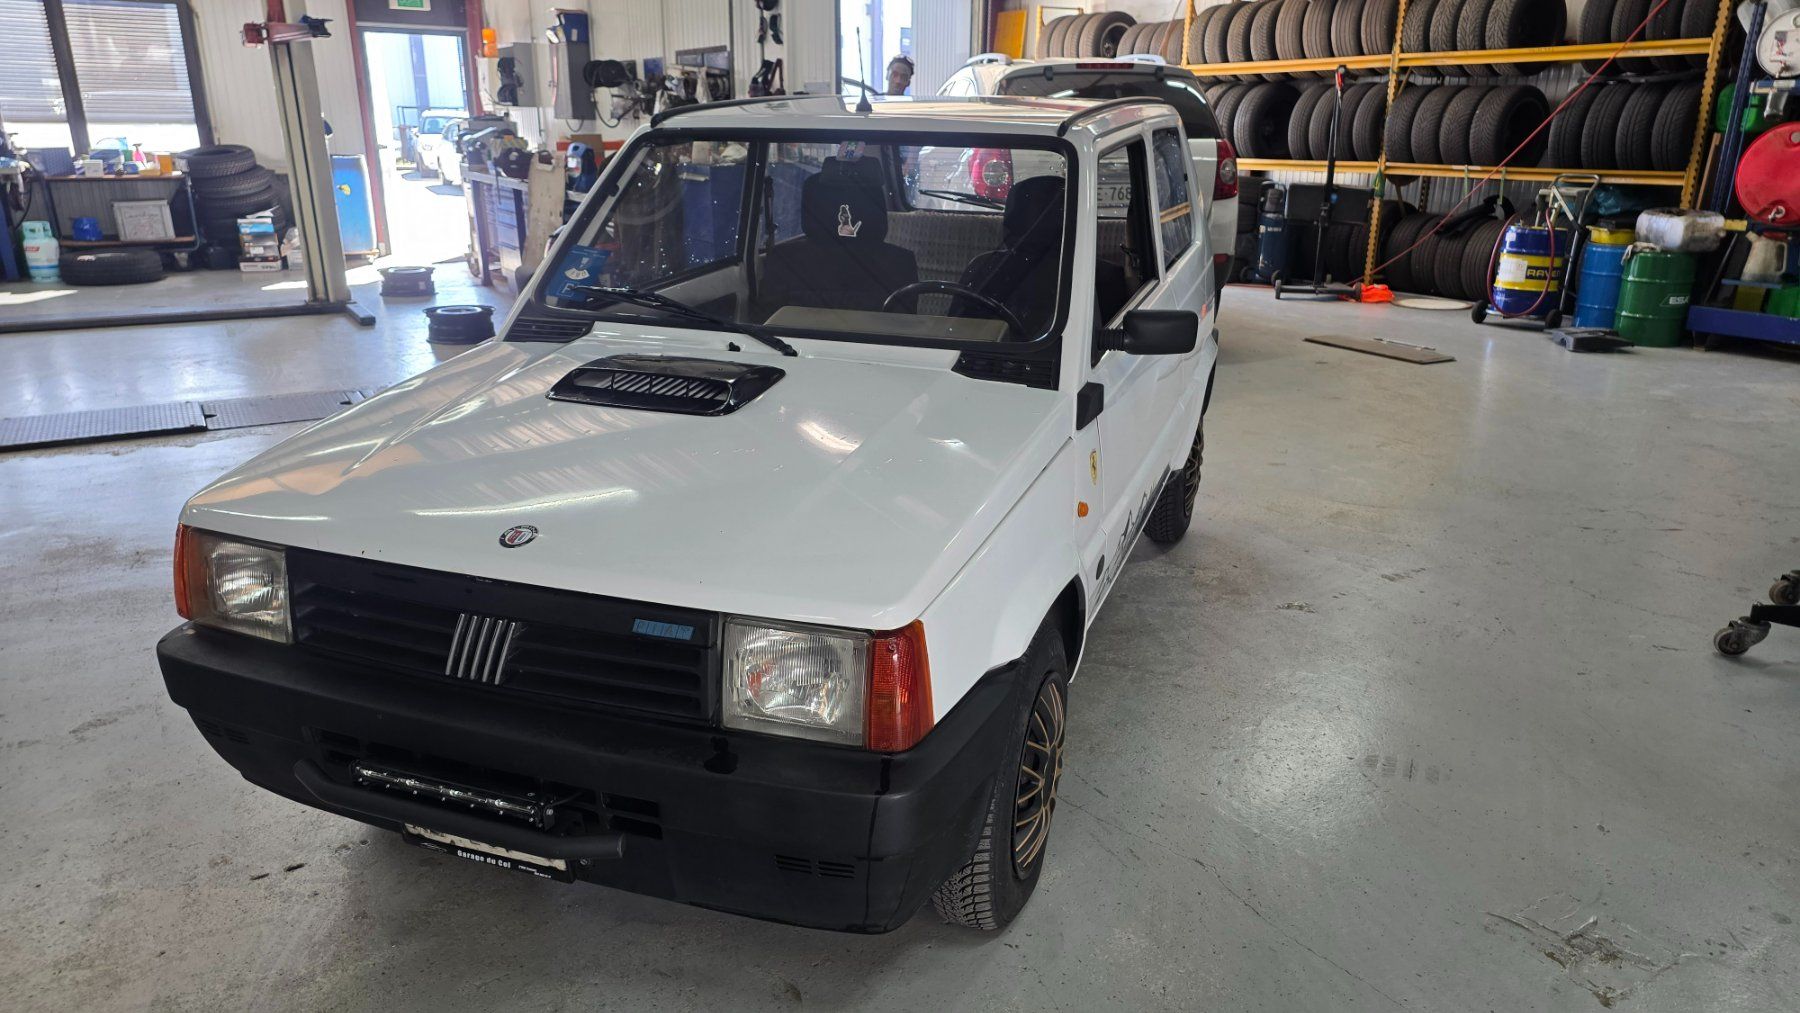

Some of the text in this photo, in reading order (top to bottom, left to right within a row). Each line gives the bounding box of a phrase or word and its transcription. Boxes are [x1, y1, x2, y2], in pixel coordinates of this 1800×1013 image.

[457, 850, 511, 868] Garage du Col
